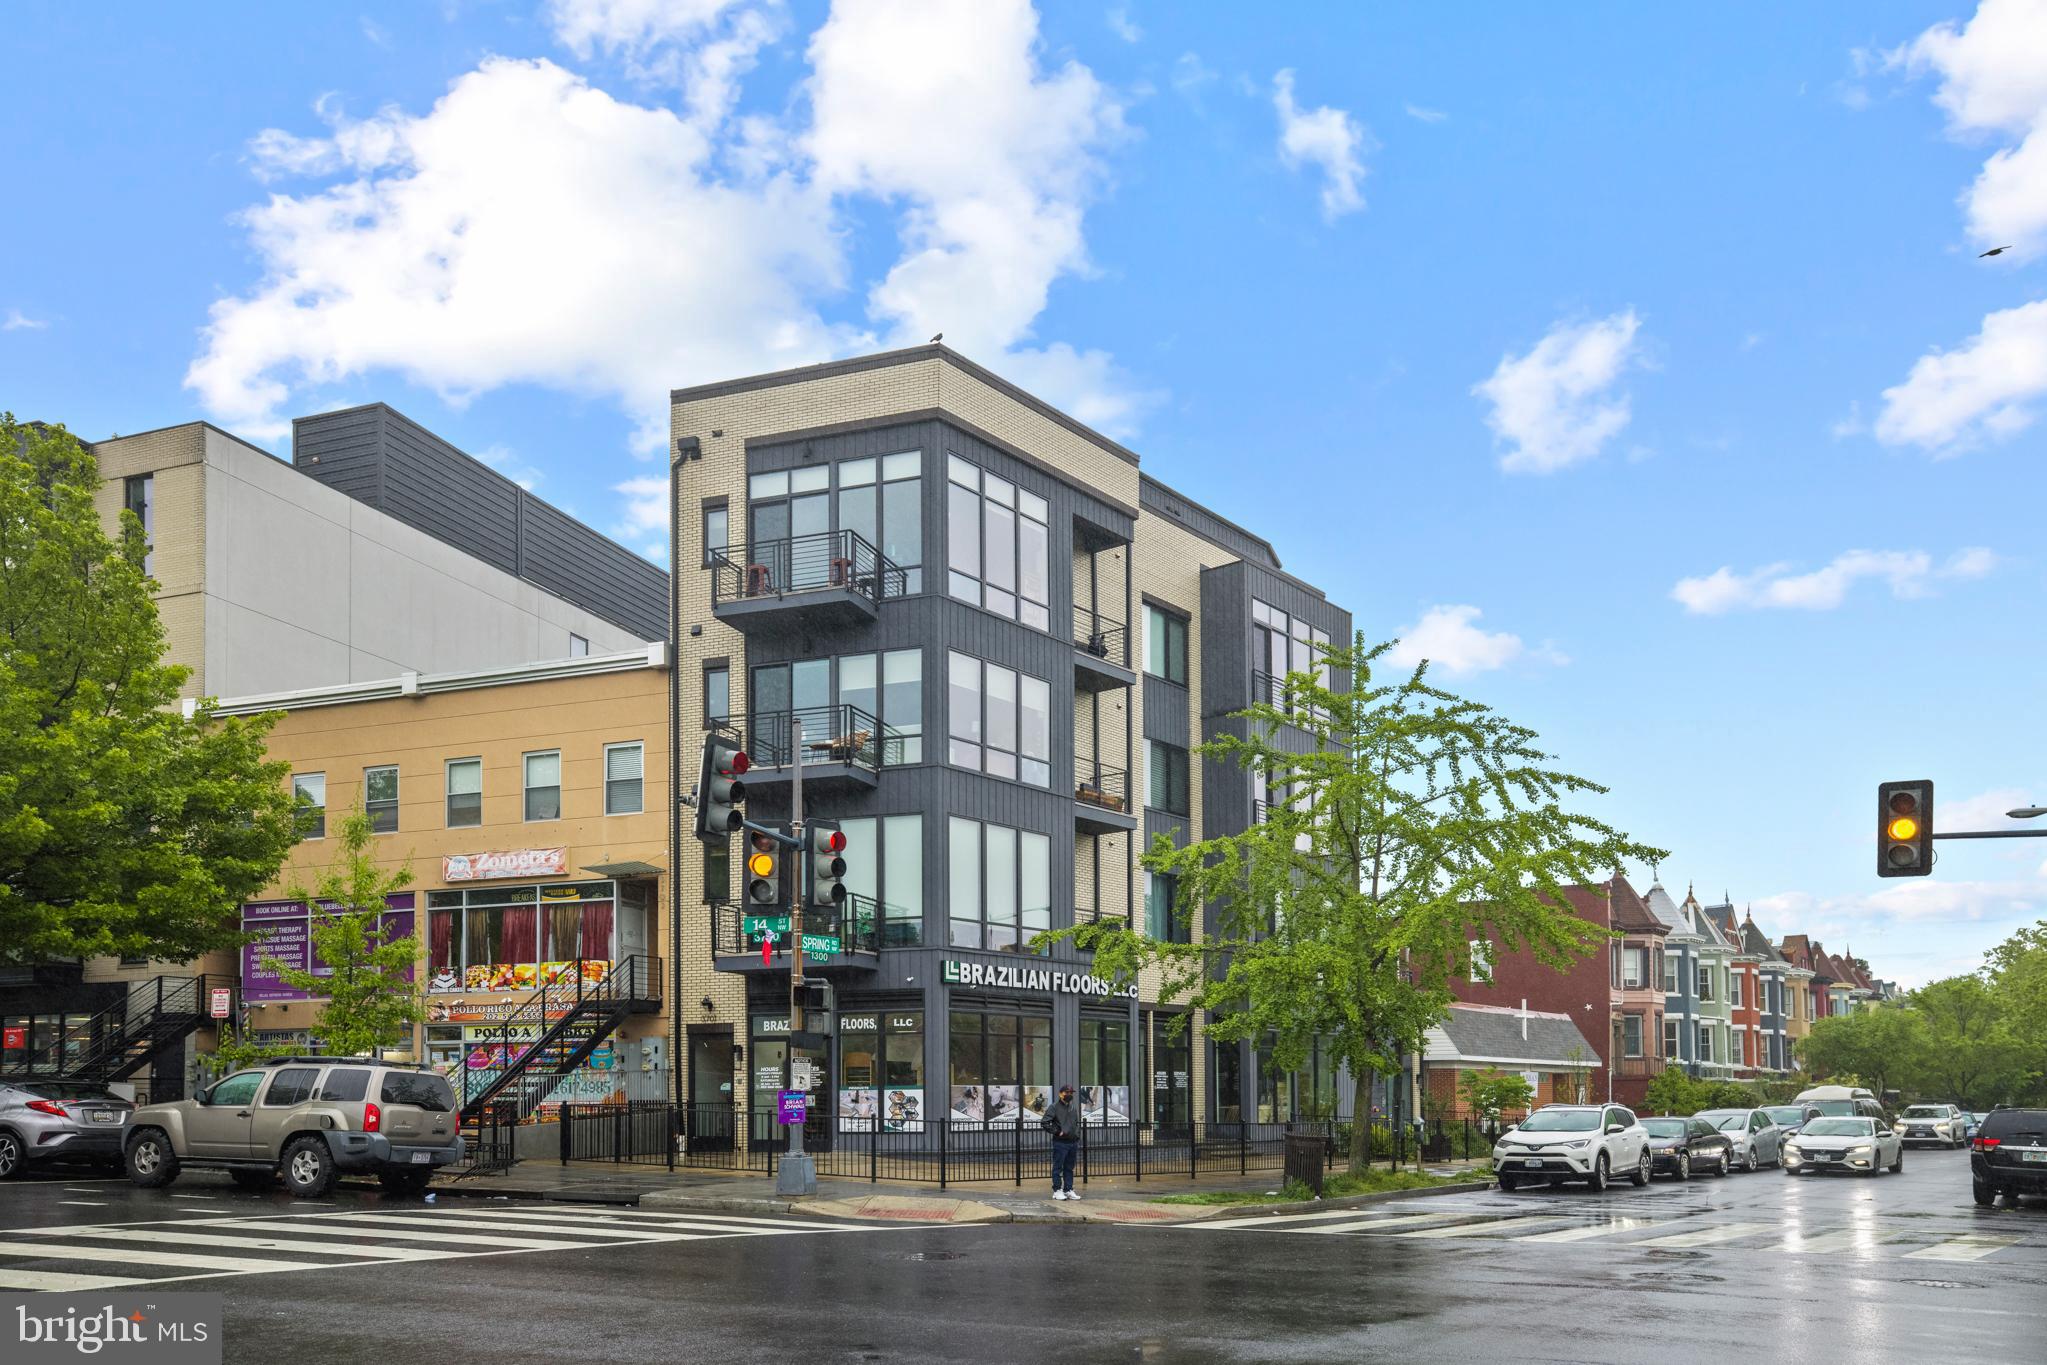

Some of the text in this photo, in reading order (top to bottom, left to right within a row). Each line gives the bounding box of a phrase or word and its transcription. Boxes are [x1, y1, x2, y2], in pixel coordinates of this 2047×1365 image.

[477, 851, 560, 869] Zometa's
[278, 926, 303, 934] THERAPY
[752, 919, 767, 930] 14
[802, 936, 830, 950] SPRING
[811, 952, 828, 961] 1300
[960, 962, 1049, 990] BRAZILIAN
[1053, 972, 1109, 996] FLOORS
[452, 1005, 485, 1014] POLLO
[487, 1004, 512, 1013] RICO
[763, 1017, 913, 1031] BRAZ FLOORS, LLC
[475, 1028, 517, 1038] POLLO
